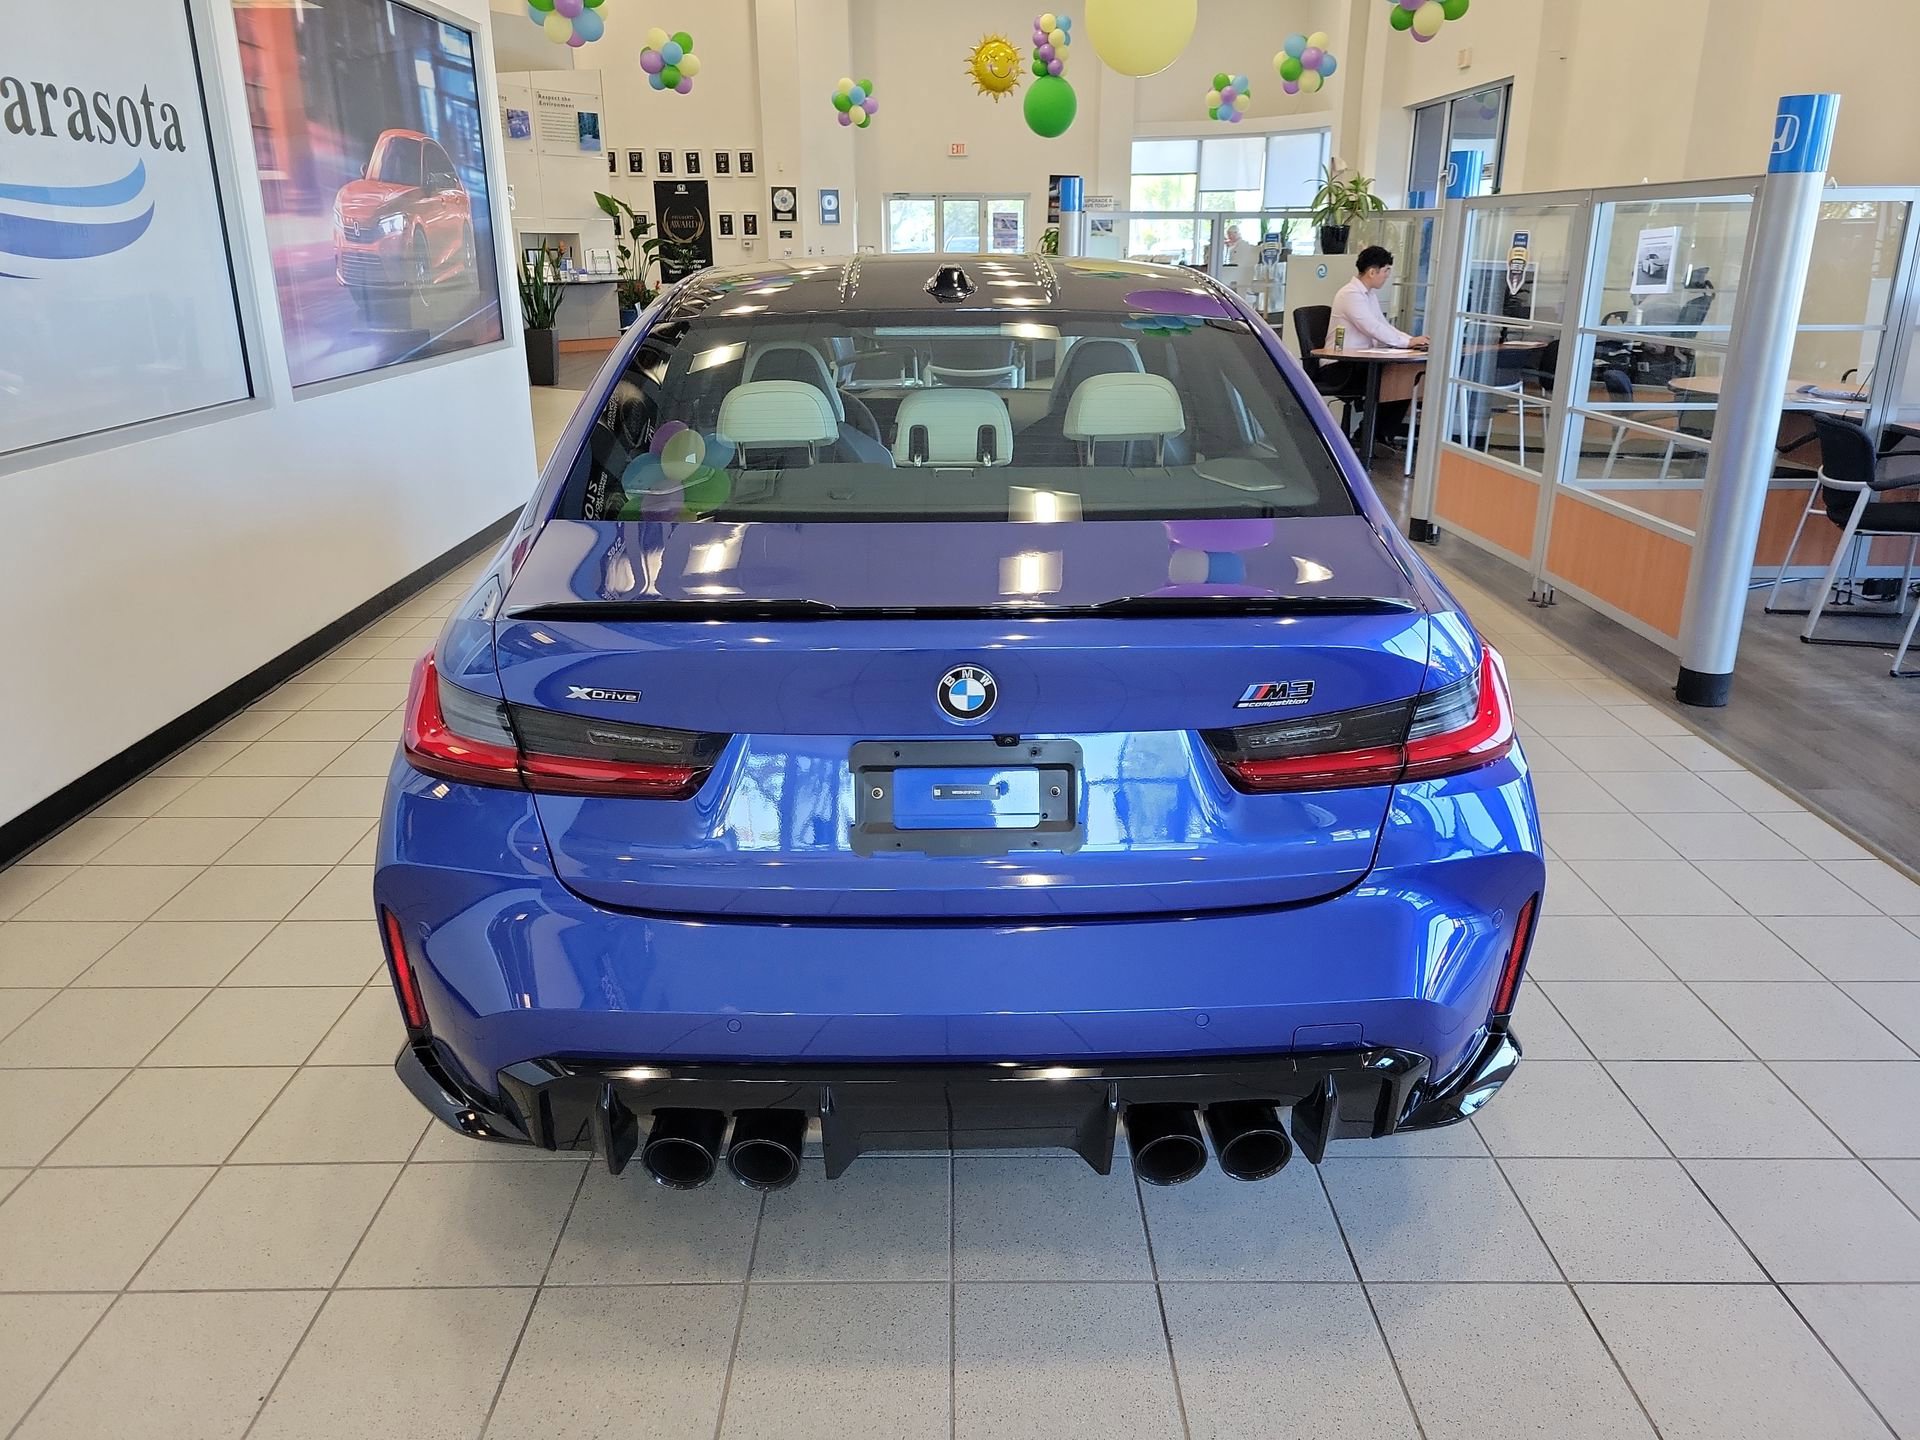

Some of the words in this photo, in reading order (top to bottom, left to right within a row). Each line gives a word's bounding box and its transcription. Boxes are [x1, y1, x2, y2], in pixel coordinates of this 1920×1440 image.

[0, 76, 186, 152] arasota
[951, 143, 965, 155] EXIT
[943, 669, 993, 688] BMW
